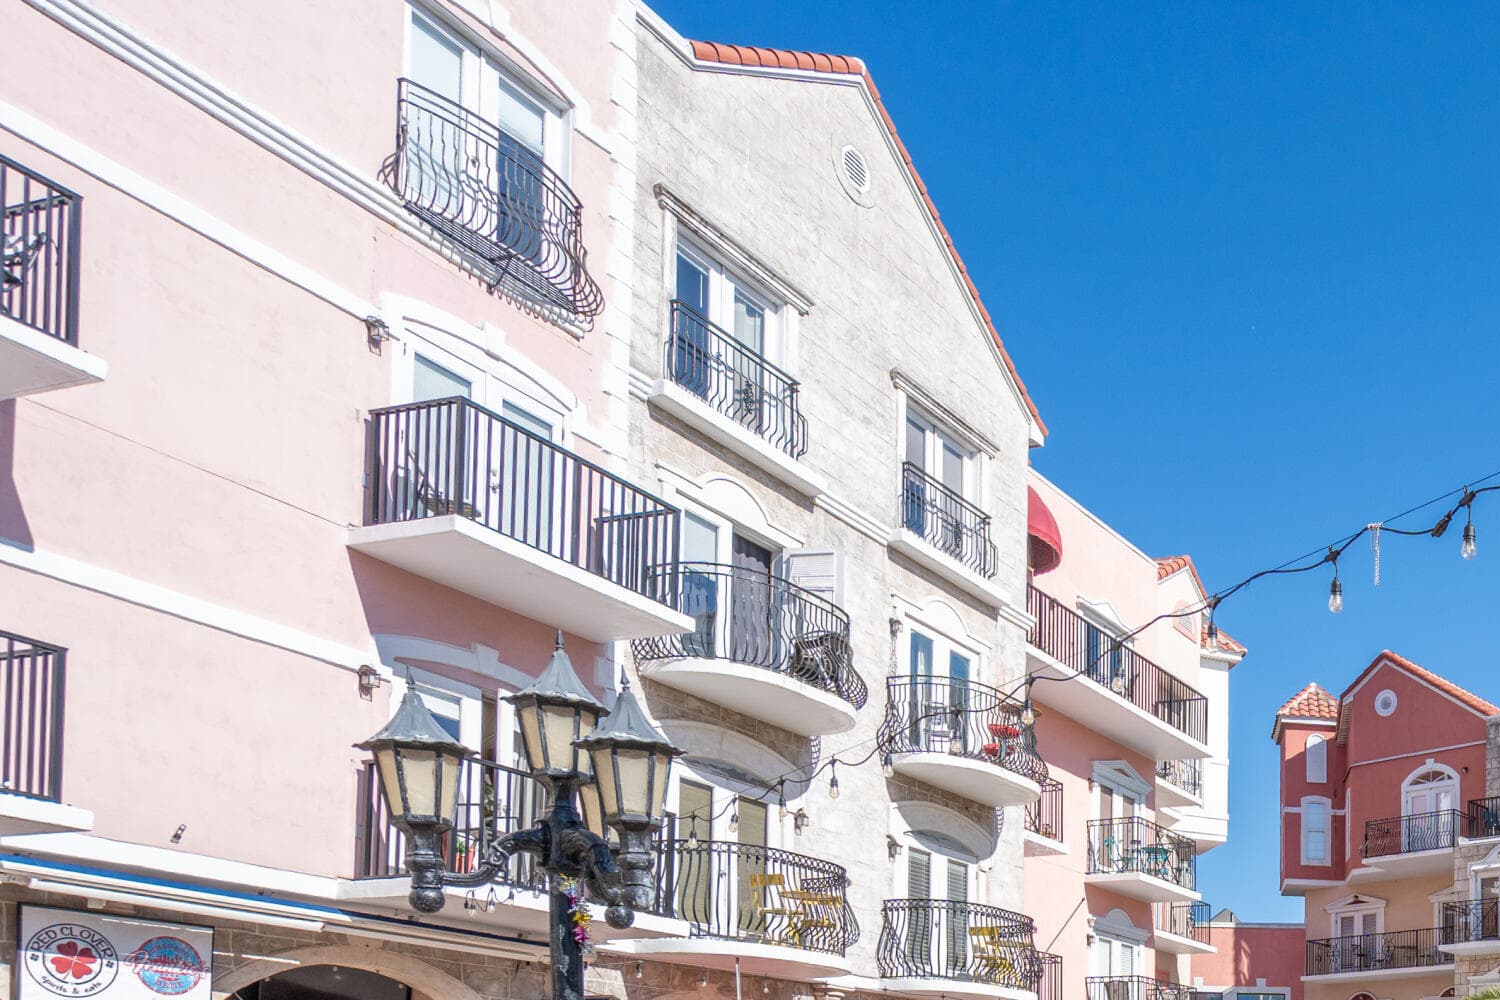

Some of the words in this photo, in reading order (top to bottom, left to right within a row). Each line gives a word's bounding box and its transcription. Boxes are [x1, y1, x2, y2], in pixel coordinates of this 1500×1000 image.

[30, 930, 57, 952] RED
[60, 926, 114, 958] CLOVER
[84, 982, 103, 993] eats
